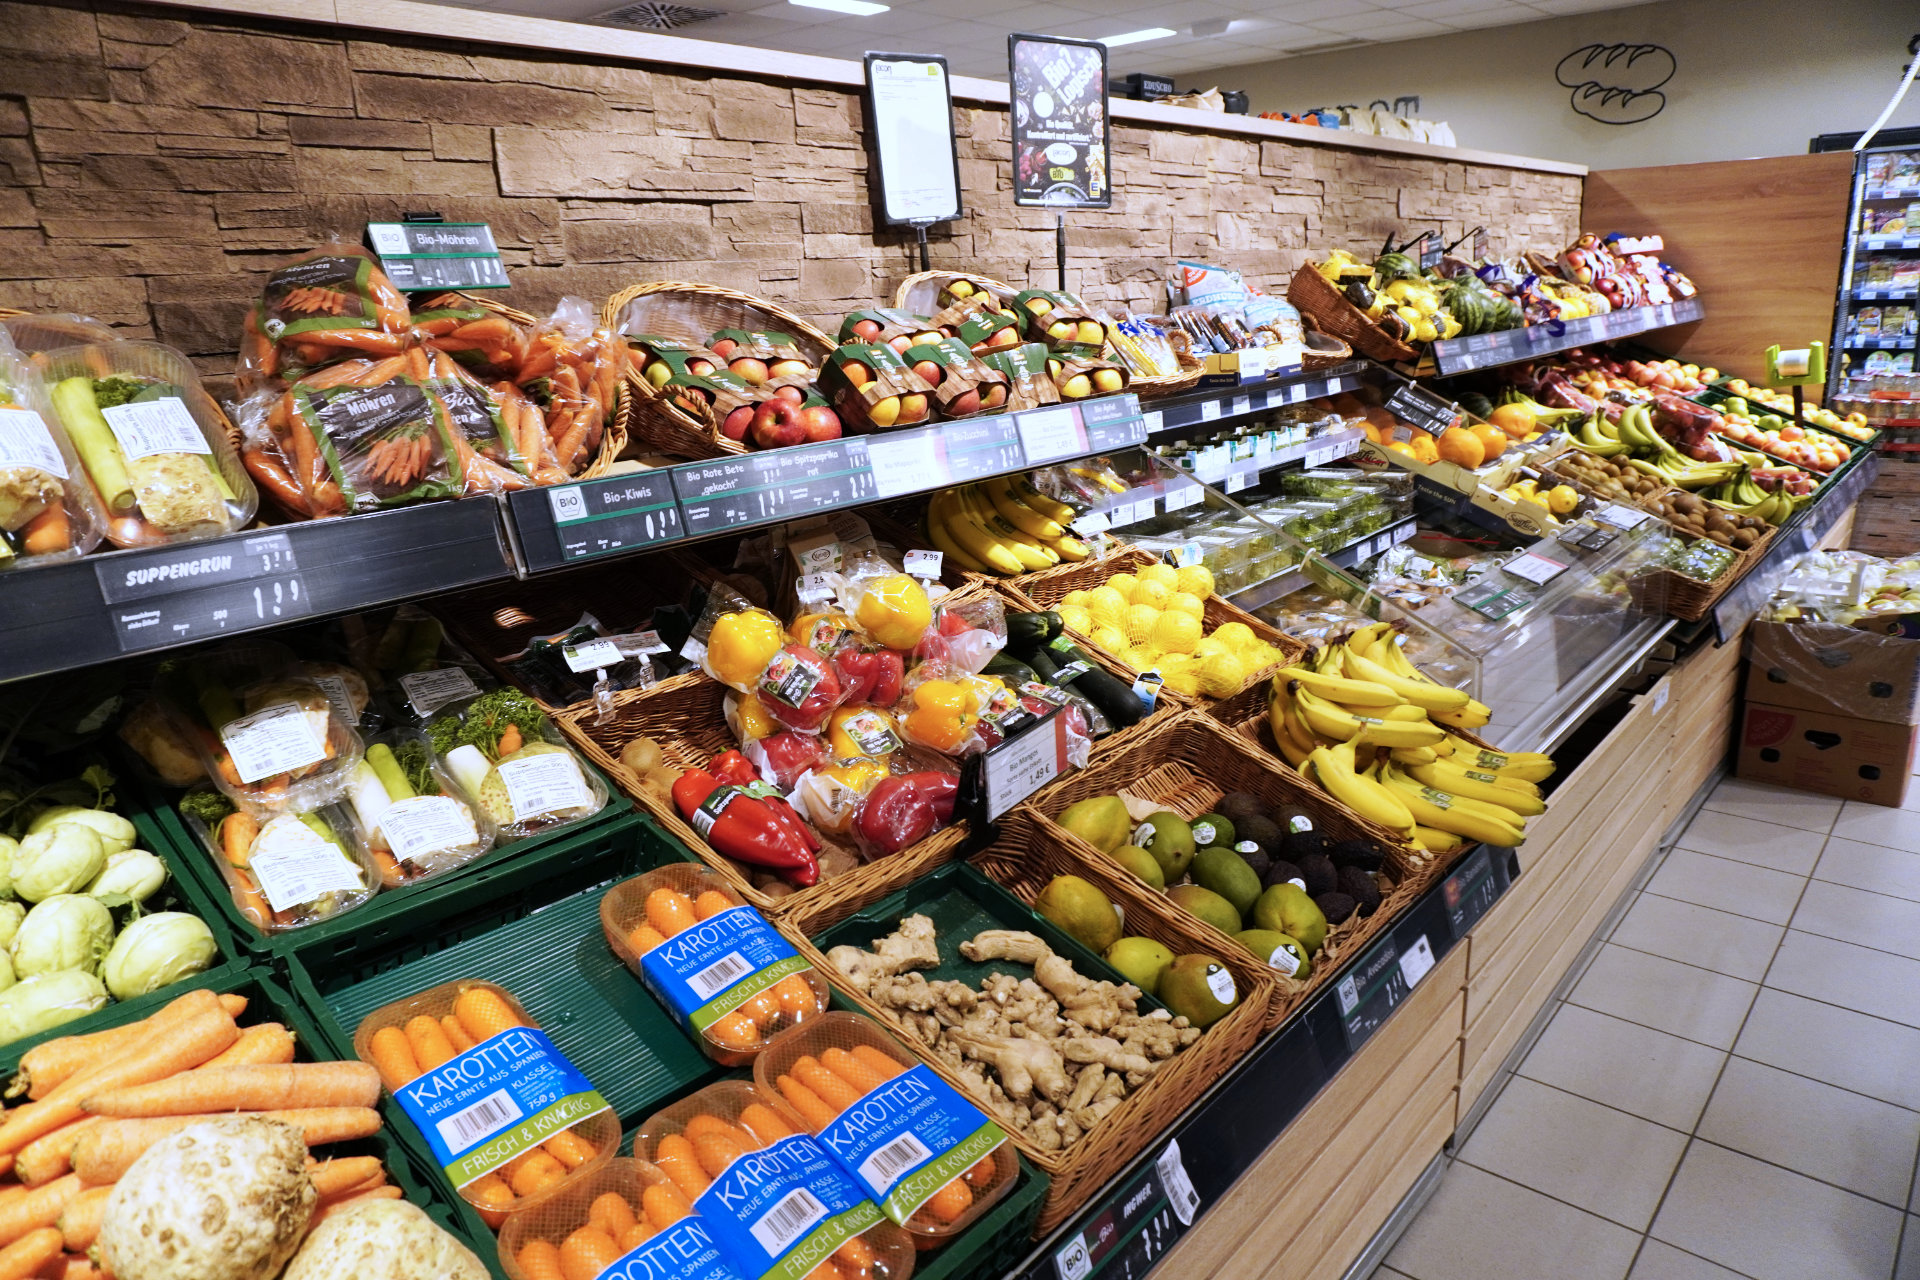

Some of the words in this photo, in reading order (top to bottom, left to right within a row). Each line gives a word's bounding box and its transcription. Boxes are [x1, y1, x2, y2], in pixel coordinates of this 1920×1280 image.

[1042, 47, 1076, 90] Bio?
[1056, 49, 1102, 106] Logisch!
[1143, 80, 1172, 92] EDUSCHO
[416, 232, 479, 246] Bio-Möhren
[346, 392, 397, 416] Möhren
[441, 391, 475, 409] Bio
[686, 470, 700, 481] Bio
[703, 468, 723, 478] Rote
[725, 464, 745, 475] Bete
[780, 457, 793, 467] Bio
[794, 450, 839, 465] Spitzpaprika
[807, 467, 819, 477] rot
[559, 496, 578, 508] BIO
[603, 487, 652, 504] Bio-Kiwis
[125, 556, 233, 588] SUPPENGRÜN
[1010, 763, 1018, 771] Bio
[1019, 750, 1038, 765] Mangos
[658, 910, 762, 968] KAROTTEN
[676, 960, 698, 975] NEUE
[698, 945, 723, 964] ERNTE
[723, 936, 739, 949] AUS
[756, 956, 771, 967] 750
[1367, 947, 1395, 979] Avocados
[712, 981, 754, 1014] FRISCH
[756, 976, 766, 987] &
[408, 1030, 543, 1108] KAROTTEN
[511, 1064, 549, 1089] KLASSE
[426, 1098, 454, 1117] NEUE
[455, 1080, 487, 1102] ERNTE
[488, 1069, 509, 1085] AUS
[517, 1095, 547, 1110] 750
[549, 1092, 556, 1102] g
[824, 1074, 931, 1155] KAROTTEN
[845, 1141, 868, 1163] NEUE
[869, 1124, 894, 1143] ERNTE
[893, 1114, 909, 1127] AUS
[907, 1095, 938, 1117] SPANIEN
[914, 1112, 943, 1132] KLASSE
[462, 1136, 520, 1175] FRISCH
[521, 1127, 534, 1143] &
[533, 1097, 592, 1131] KNACKIG
[934, 1137, 951, 1150] 750
[714, 1137, 825, 1212] KAROTTEN
[890, 1170, 938, 1212] FRISCH
[937, 1165, 949, 1177] &
[945, 1134, 993, 1166] KNACKIG
[736, 1197, 763, 1221] NEUE
[762, 1176, 788, 1197] ERNTE
[804, 1159, 831, 1176] PANIEN
[830, 1199, 843, 1210] 50
[1123, 1182, 1152, 1219] INGWER
[681, 1248, 721, 1277] SPANIEN
[783, 1231, 833, 1277] FRISCH
[833, 1221, 845, 1236] &
[1065, 1249, 1083, 1272] BIO
